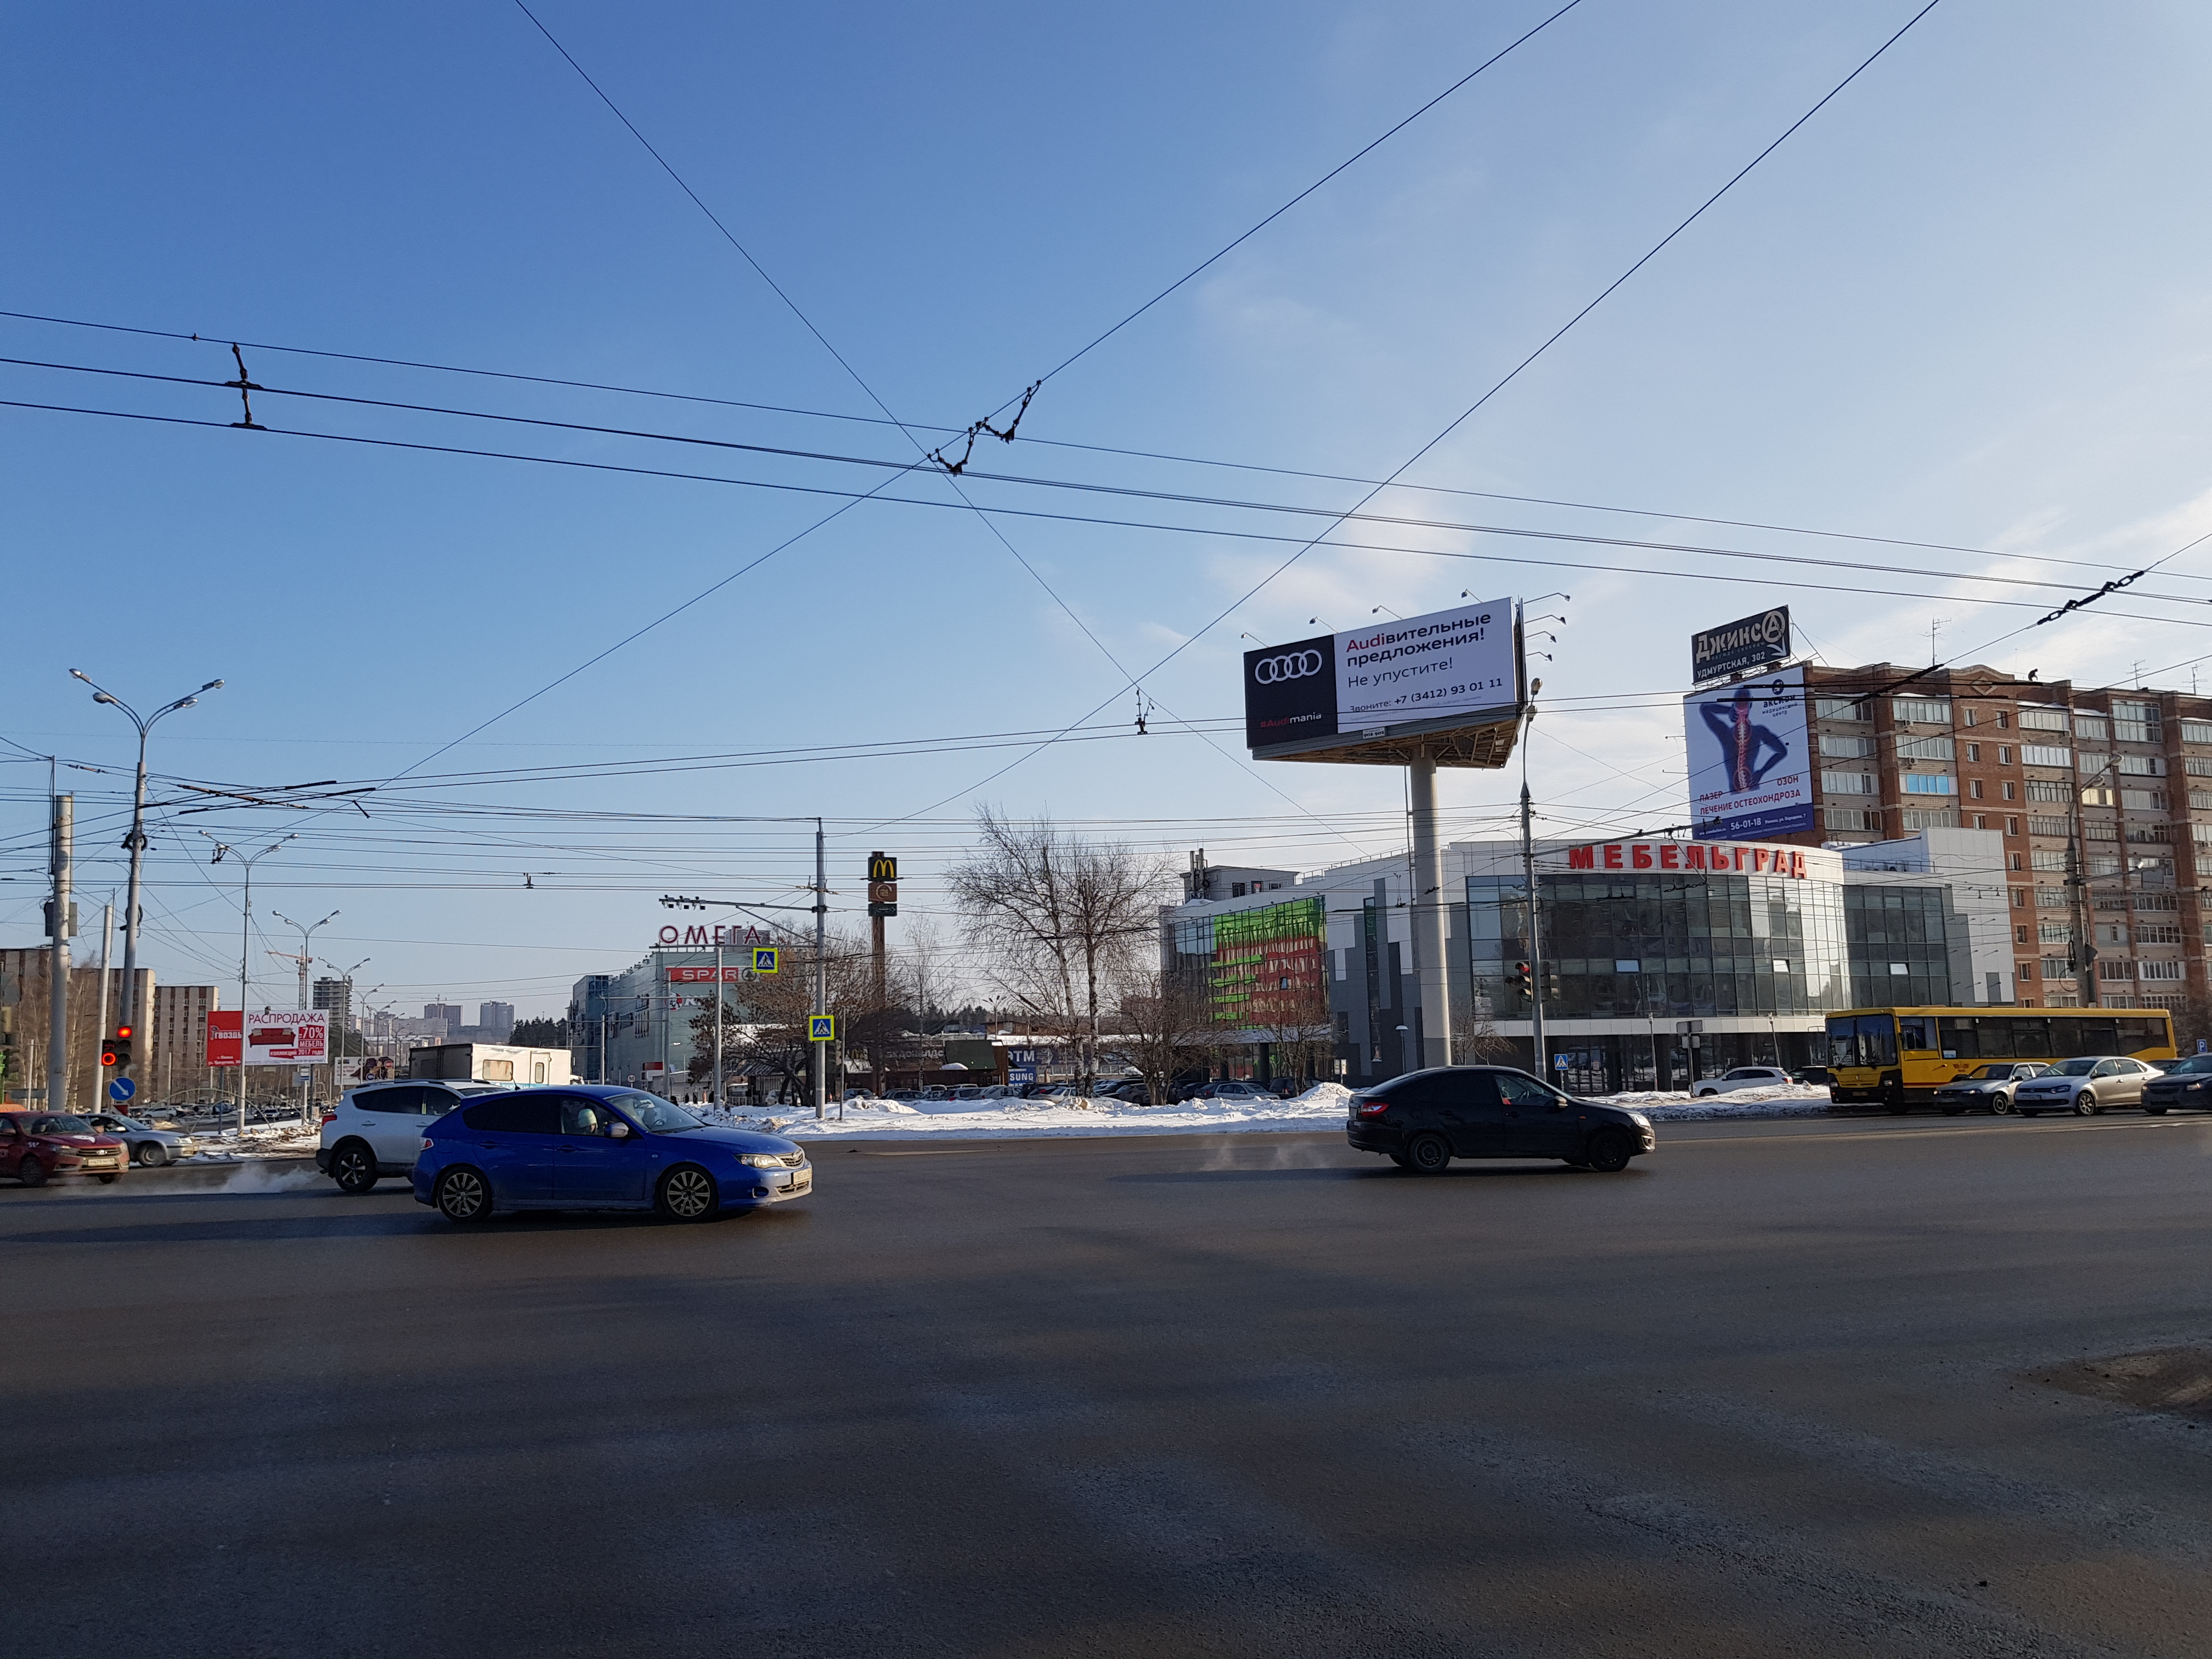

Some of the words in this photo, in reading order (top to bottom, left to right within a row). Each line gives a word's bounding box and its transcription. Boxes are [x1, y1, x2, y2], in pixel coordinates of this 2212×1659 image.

[1347, 627, 1485, 668] предложения!
[1348, 675, 1368, 688] Не
[1373, 657, 1453, 686] упустите!
[1697, 656, 1750, 679] УДМУРТСКАЯ,
[1751, 651, 1766, 662] 302
[1349, 700, 1392, 713] Звоните:
[1394, 695, 1407, 705] +7
[1410, 687, 1447, 703] (3412)
[1450, 685, 1465, 695] 93
[1469, 681, 1484, 691] 01
[1488, 678, 1503, 688] 11
[1260, 712, 1322, 727] #Audimania
[1776, 775, 1799, 786] ОЗОН
[1699, 791, 1723, 802] ЛАЗЕР
[1700, 802, 1733, 815] ЛЕЧЕНИЕ
[1734, 789, 1801, 809] ОСТЕОХОНДРОЗА
[1730, 817, 1762, 831] 56-01-18
[1568, 844, 1807, 879] МЕБЕЛЬГРАД
[659, 924, 762, 945] ОМЕГА
[249, 1013, 325, 1025] РАСПРОДАЖА
